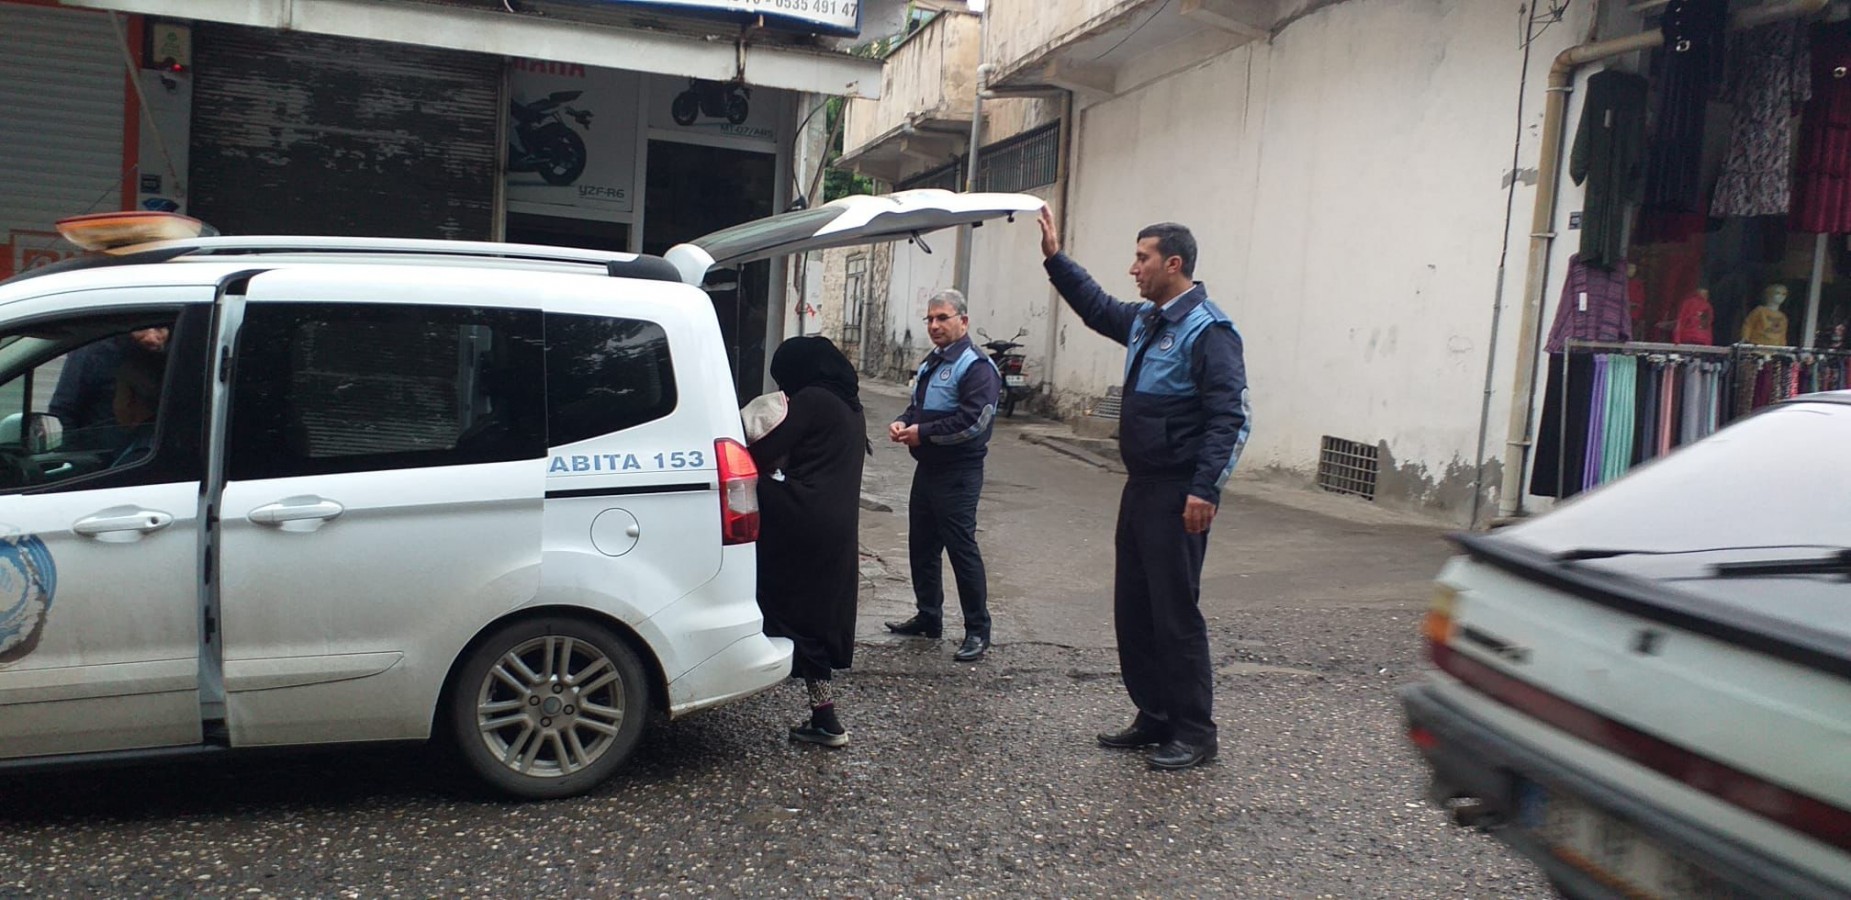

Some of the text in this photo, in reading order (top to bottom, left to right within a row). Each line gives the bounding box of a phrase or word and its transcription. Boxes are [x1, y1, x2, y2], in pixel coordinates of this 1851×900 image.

[813, 0, 835, 14] 491
[841, 3, 857, 17] 47
[578, 185, 625, 198] YZF-R6
[549, 451, 704, 473] ABITA 153
